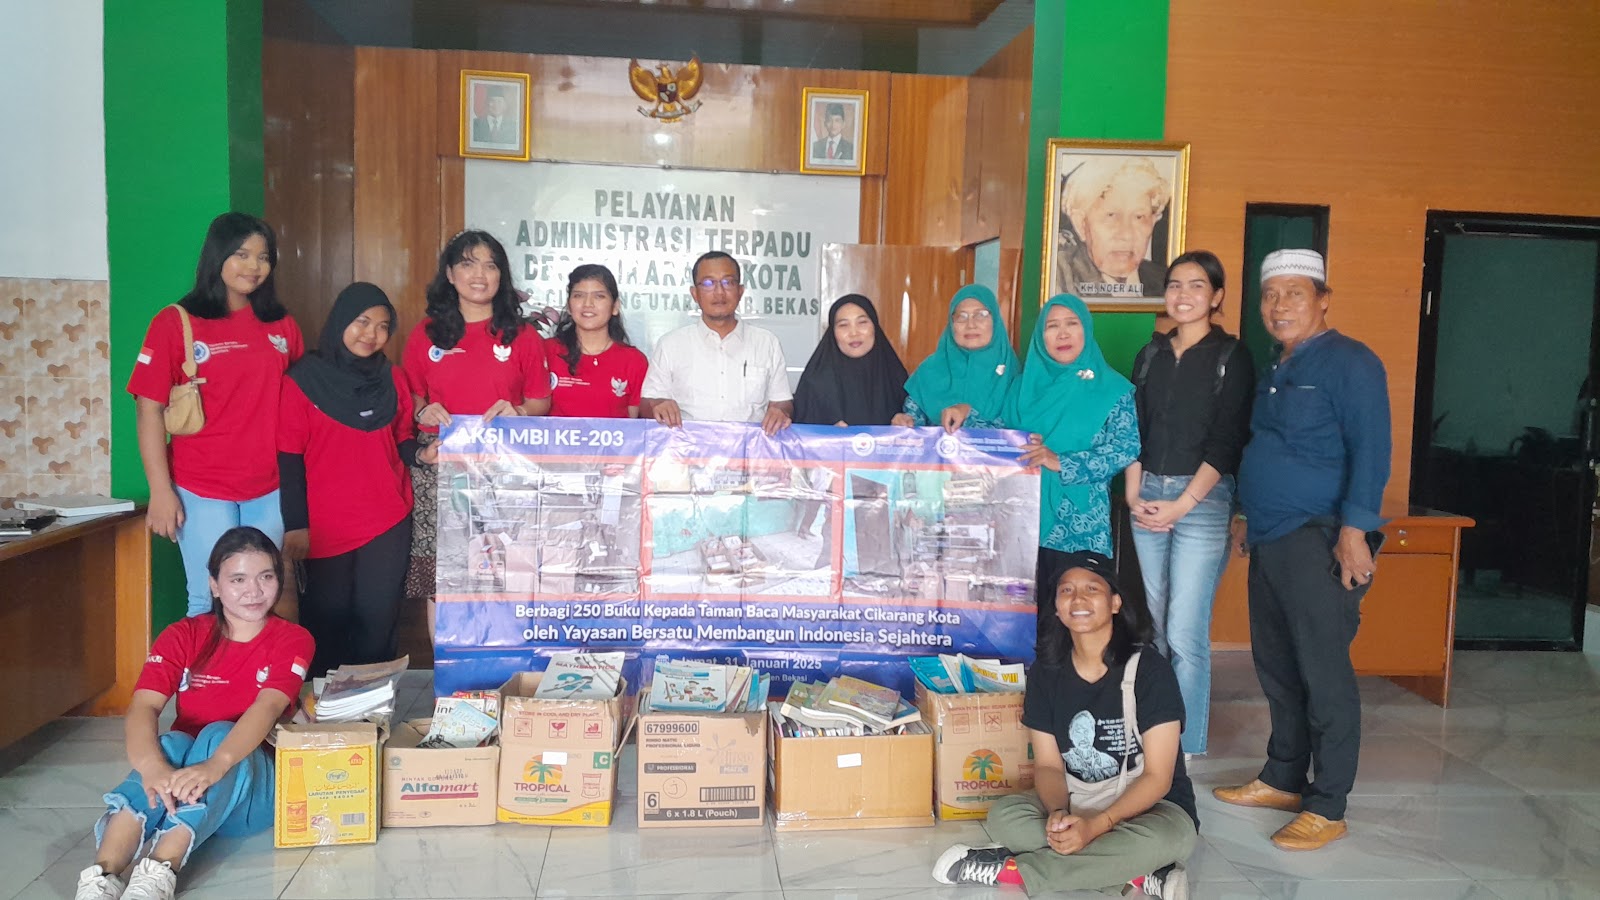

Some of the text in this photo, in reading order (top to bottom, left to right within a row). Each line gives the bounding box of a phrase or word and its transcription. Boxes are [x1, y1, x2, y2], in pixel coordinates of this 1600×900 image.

[594, 189, 735, 223] PELAYANAN
[515, 219, 811, 259] ADMINISTRASI TERPADU
[743, 263, 803, 291] KOTA
[1100, 284, 1125, 293] NOER
[1128, 284, 1144, 294] ALI
[454, 427, 624, 447] AKSI MBI KE-203
[515, 603, 960, 625] Berbagi 250 Buku Kepada Taman Baca Masyarakat Cikarang Kota
[523, 623, 953, 646] oleh Yayasan Bersatu Membangun Indonesia Sejahtera
[742, 655, 790, 669] Januari
[792, 656, 822, 670] 2025
[781, 674, 808, 683] Bekasi
[646, 723, 698, 733] 67999600
[599, 755, 609, 764] C
[401, 781, 479, 792] Alfamart
[514, 782, 570, 793] TROPICAL
[954, 779, 1012, 791] TROPICAL
[647, 793, 657, 808] 6
[666, 810, 672, 818] 6
[682, 810, 695, 818] 1.8
[705, 809, 738, 819] (Pouch)
